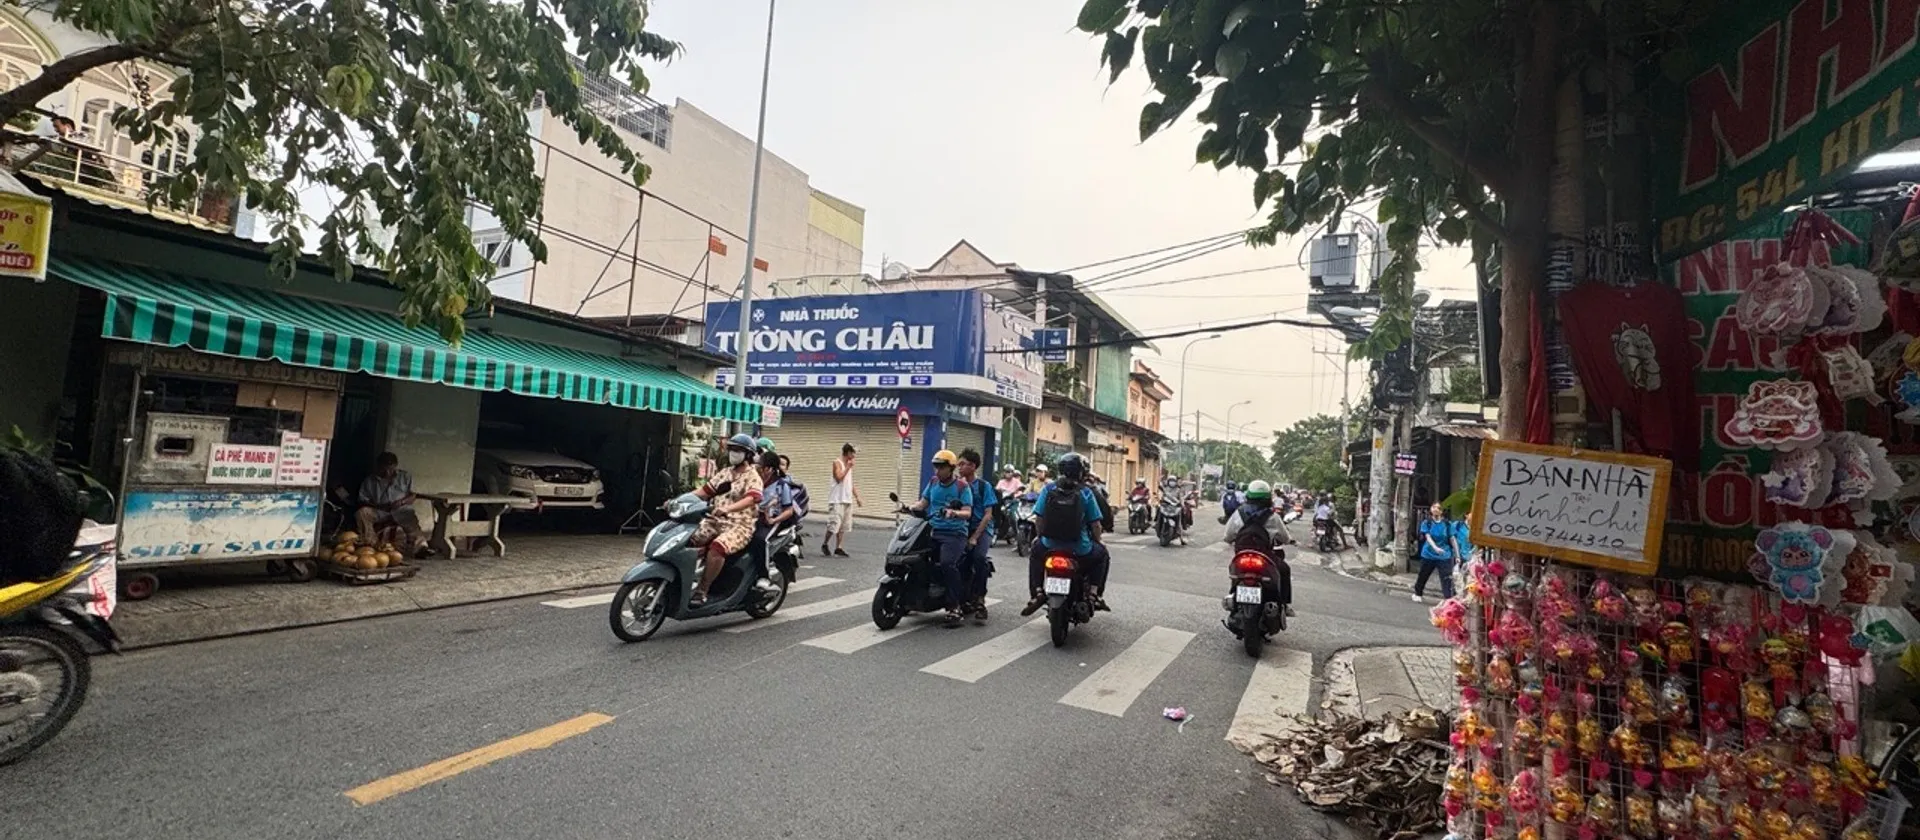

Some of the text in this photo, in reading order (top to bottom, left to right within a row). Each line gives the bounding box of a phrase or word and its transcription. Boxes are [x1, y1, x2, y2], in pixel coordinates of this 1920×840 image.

[25, 215, 34, 225] 6
[780, 303, 859, 322] NHÀ THUỐC
[835, 321, 935, 351] CHÂU
[776, 393, 813, 408] CHÀO
[848, 394, 900, 410] KHÁCH
[214, 448, 225, 462] CÀ
[226, 448, 242, 463] PHÊ
[243, 450, 266, 463] MANG
[1500, 457, 1651, 498] BÁN-NHÀ
[1488, 522, 1625, 549] 0906744310
[129, 538, 306, 558] SIÊU SẠCH
